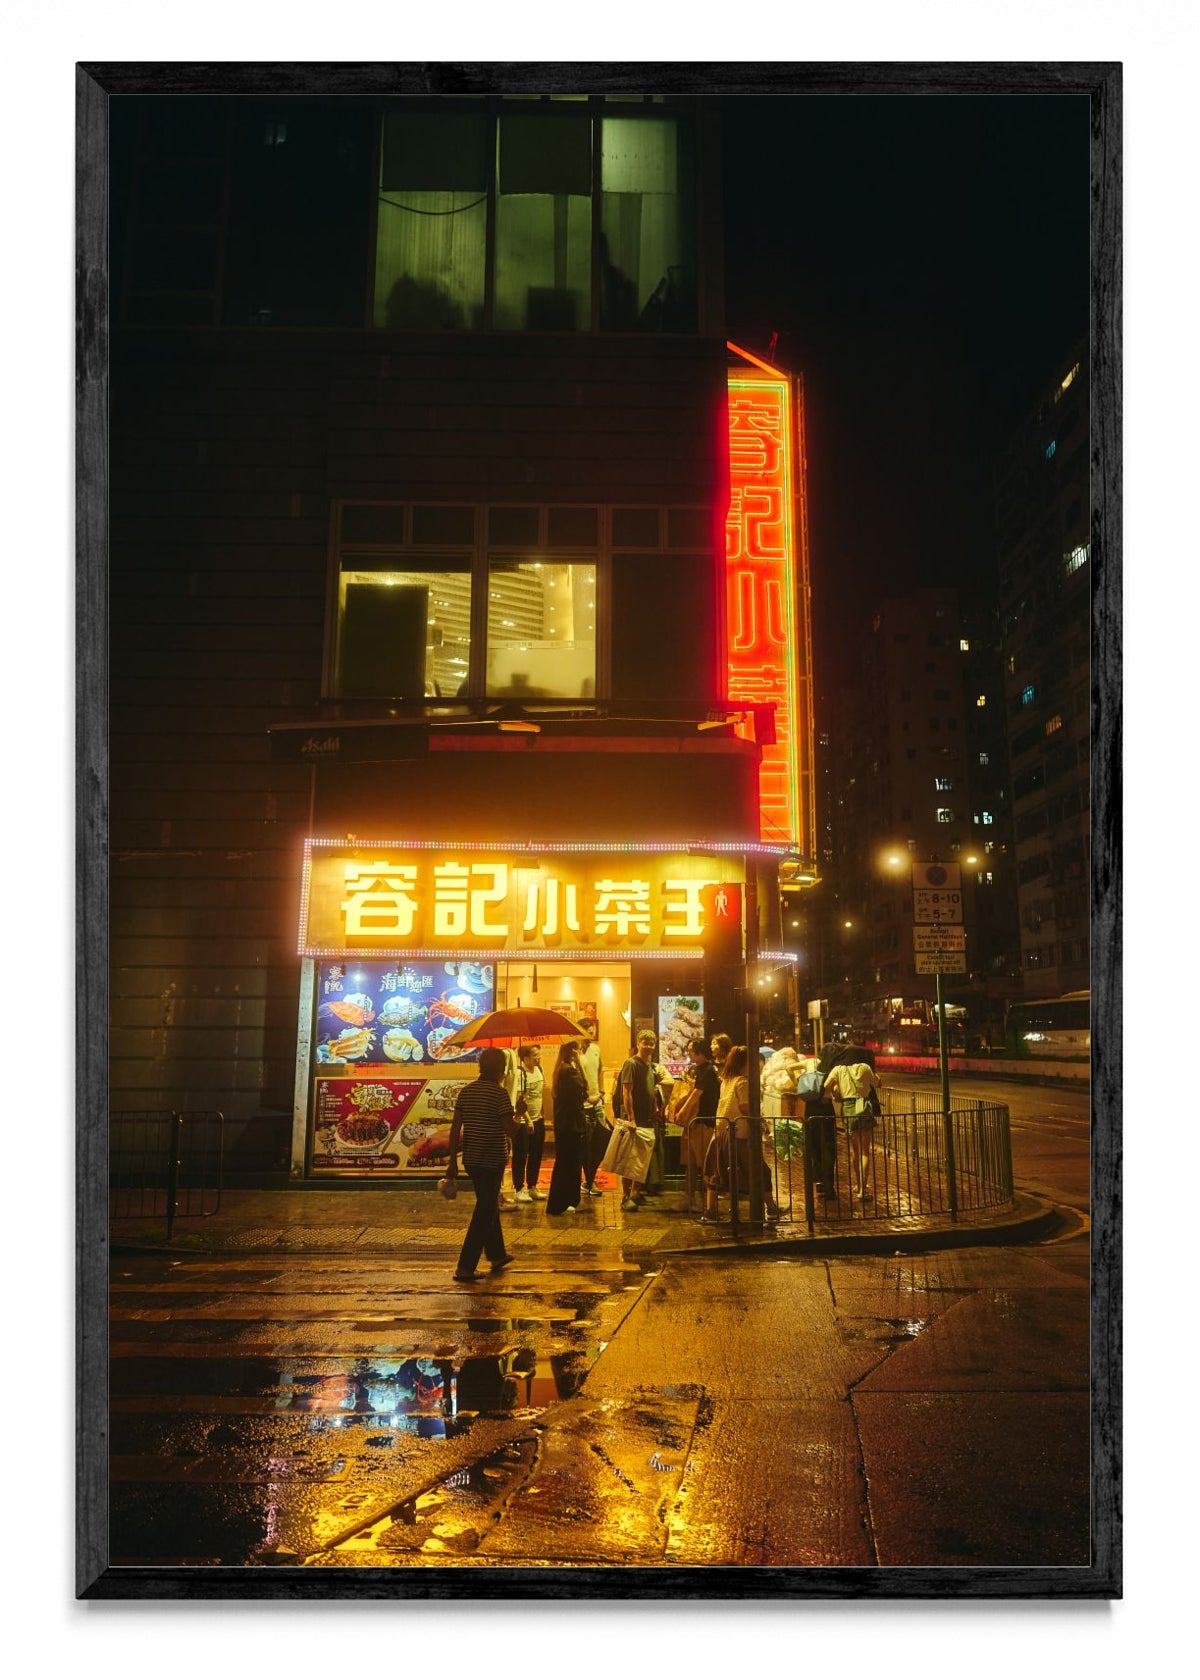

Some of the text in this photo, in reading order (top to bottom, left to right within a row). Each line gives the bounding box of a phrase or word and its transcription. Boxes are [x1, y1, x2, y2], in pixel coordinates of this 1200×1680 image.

[340, 861, 720, 936] 容記小菜王
[932, 893, 960, 904] 8-10
[933, 908, 956, 919] 5-7
